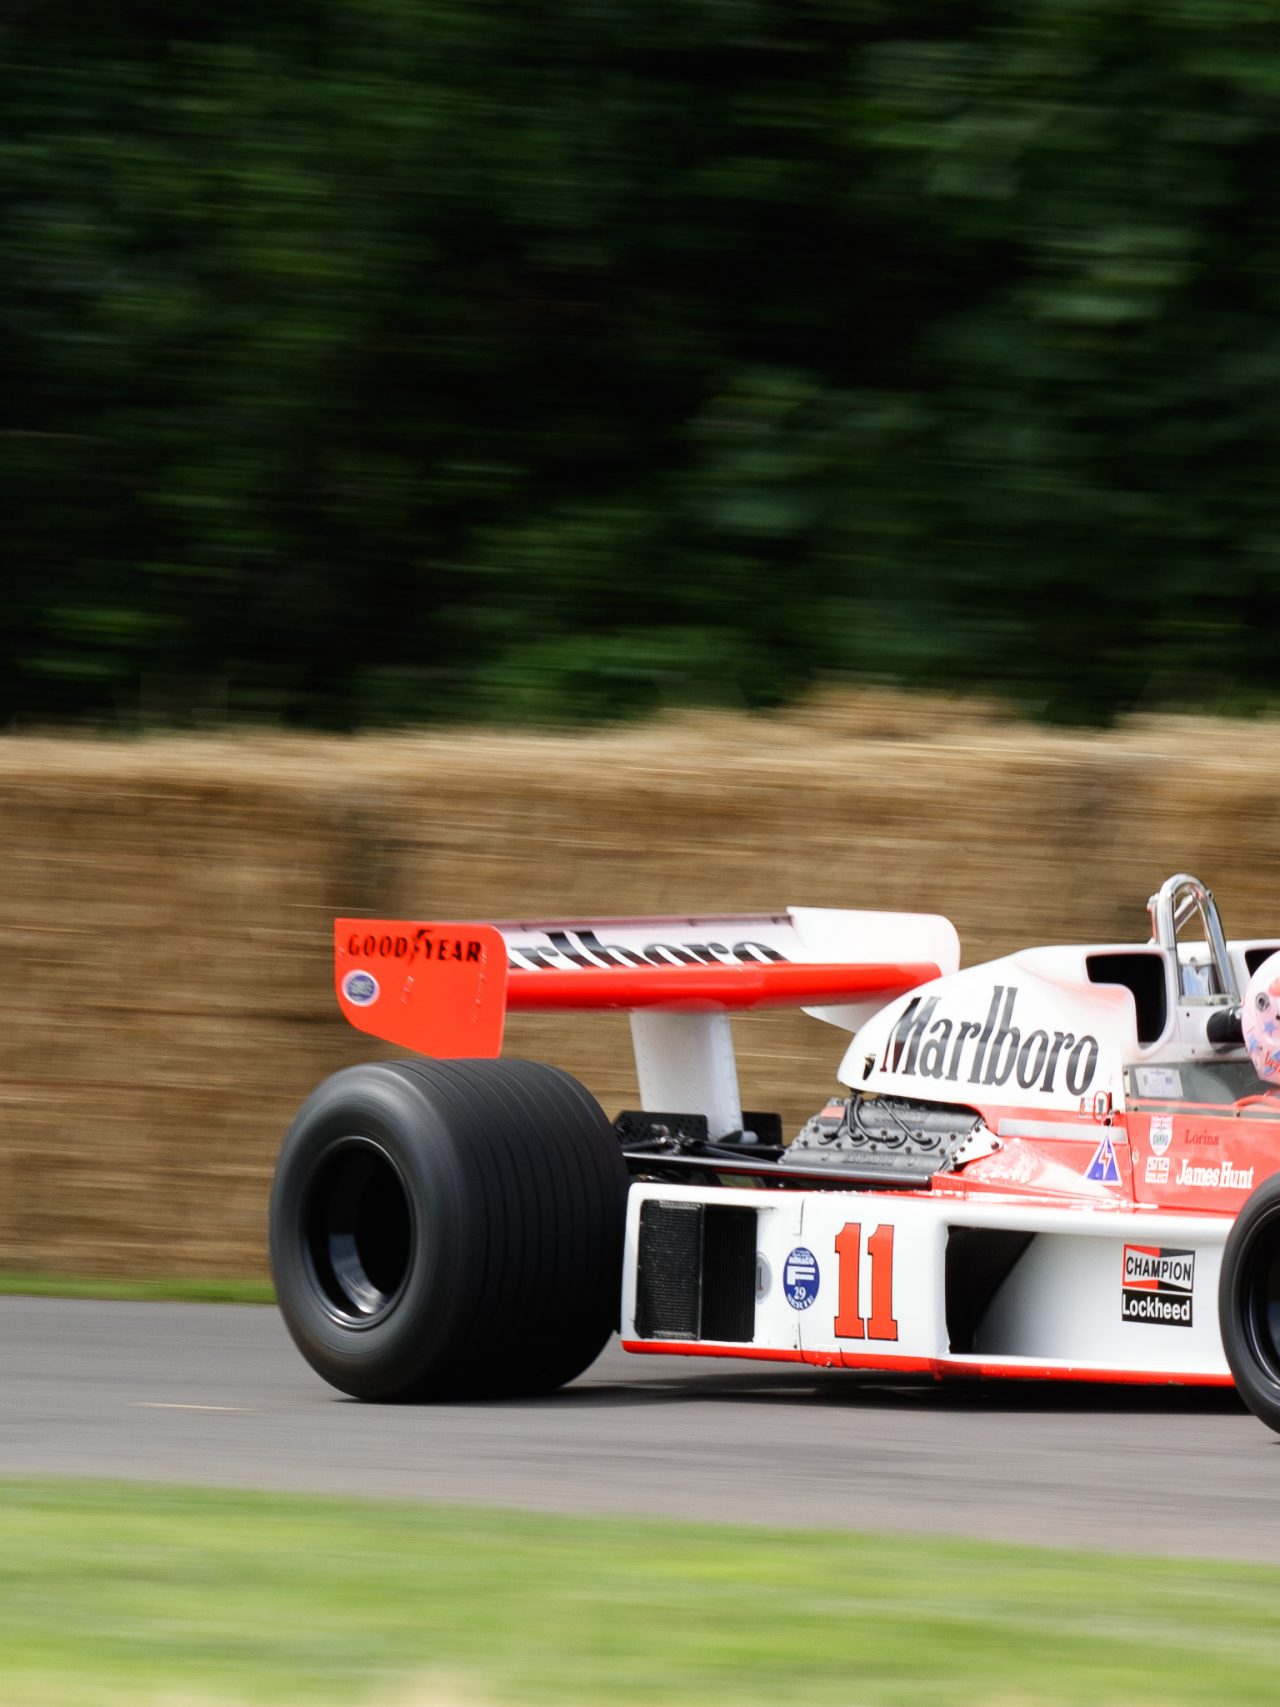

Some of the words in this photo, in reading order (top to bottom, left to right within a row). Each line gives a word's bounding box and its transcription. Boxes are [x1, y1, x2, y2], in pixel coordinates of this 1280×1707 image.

[508, 929, 790, 967] rlboro
[880, 985, 1099, 1096] Marlboro
[1184, 1129, 1219, 1146] Lorina
[1176, 1158, 1219, 1187] James
[1219, 1161, 1254, 1189] Hunt
[833, 1221, 899, 1342] 11
[1126, 1256, 1192, 1281] CHAMPION
[793, 1286, 807, 1301] 29
[1122, 1293, 1191, 1321] Lockheed
